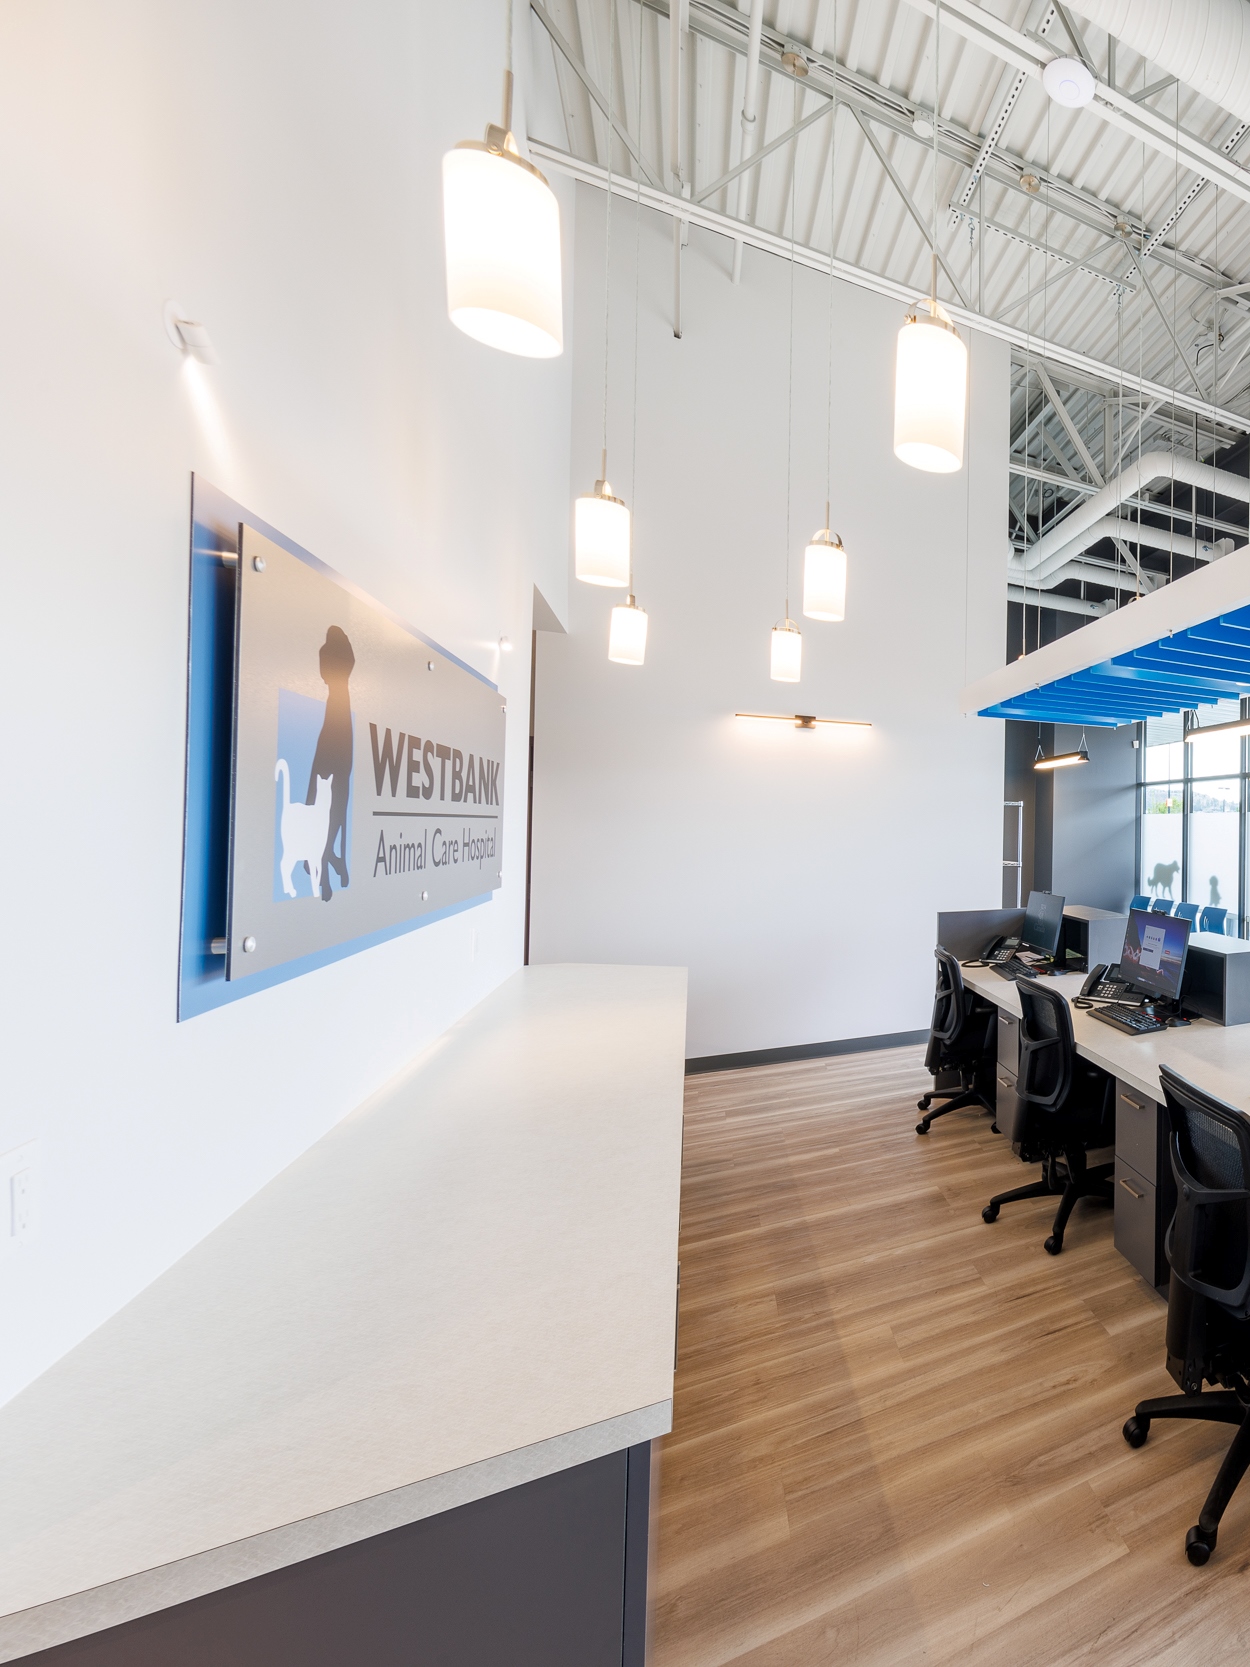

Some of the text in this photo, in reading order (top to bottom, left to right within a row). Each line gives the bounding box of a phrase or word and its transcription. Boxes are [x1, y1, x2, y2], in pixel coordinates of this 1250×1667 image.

[369, 722, 500, 806] WESTBANK
[373, 827, 497, 878] Animal Care Hospital
